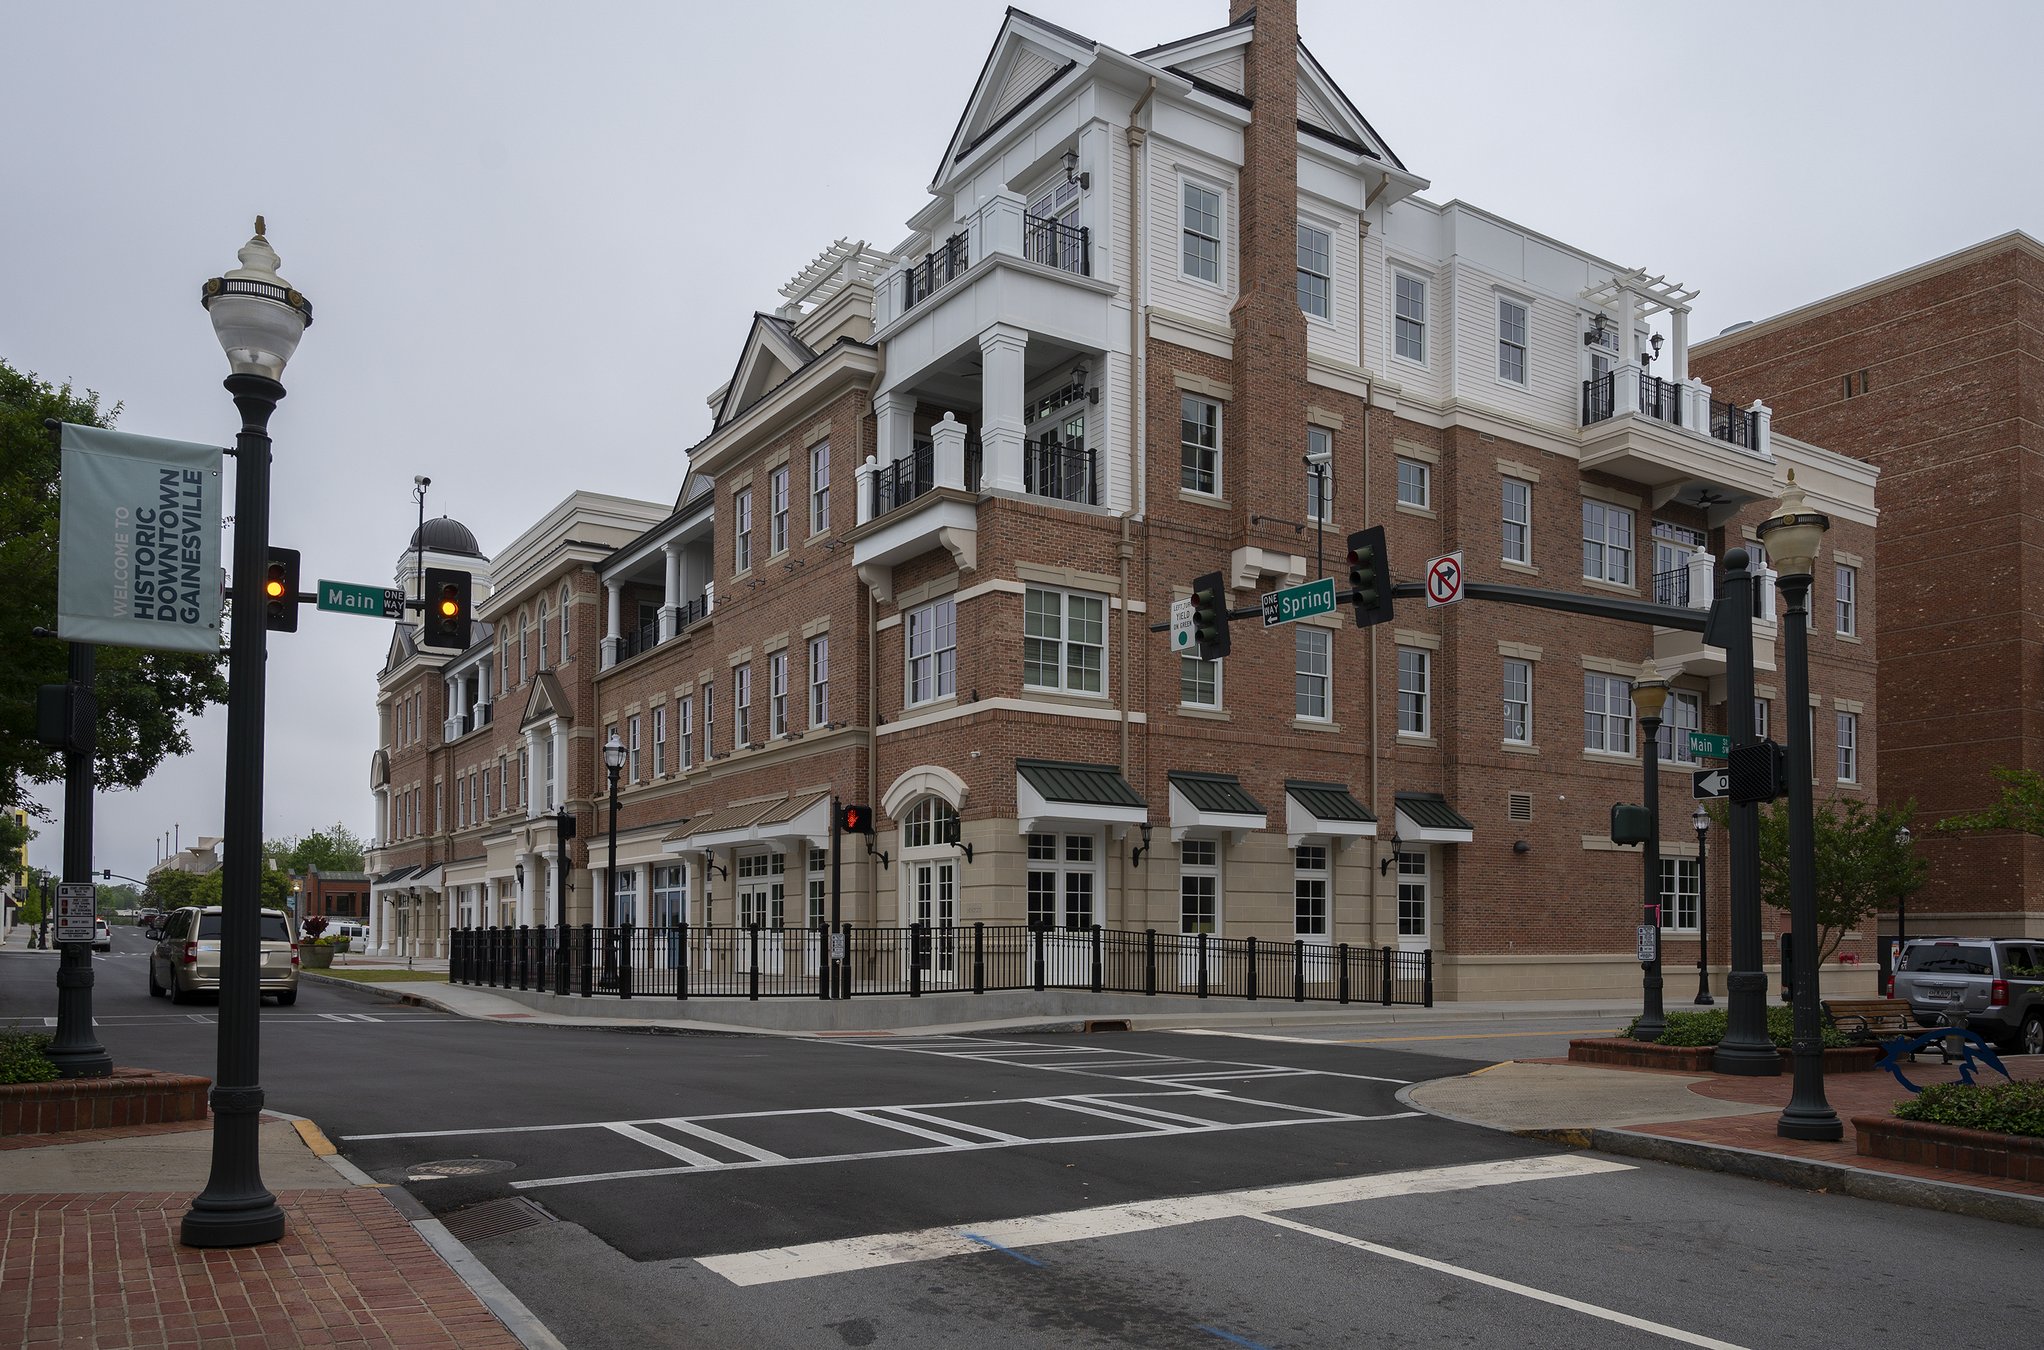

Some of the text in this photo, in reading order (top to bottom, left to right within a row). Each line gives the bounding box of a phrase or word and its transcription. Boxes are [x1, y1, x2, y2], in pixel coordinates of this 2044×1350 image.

[157, 468, 180, 622] DOWNTOWN
[180, 469, 203, 625] GAINESVILLE
[114, 506, 130, 617] WELCOME TO
[134, 506, 156, 620] HISTORIC
[329, 589, 374, 609] Main
[384, 590, 403, 600] ONE
[1263, 593, 1278, 605] ONE
[384, 600, 403, 609] WAY
[1173, 603, 1183, 611] LEFT
[1264, 605, 1278, 615] WAY
[1282, 590, 1331, 617] Spring
[1176, 610, 1191, 621] YIELD
[1180, 620, 1192, 628] GREEN
[1690, 738, 1712, 752] Main
